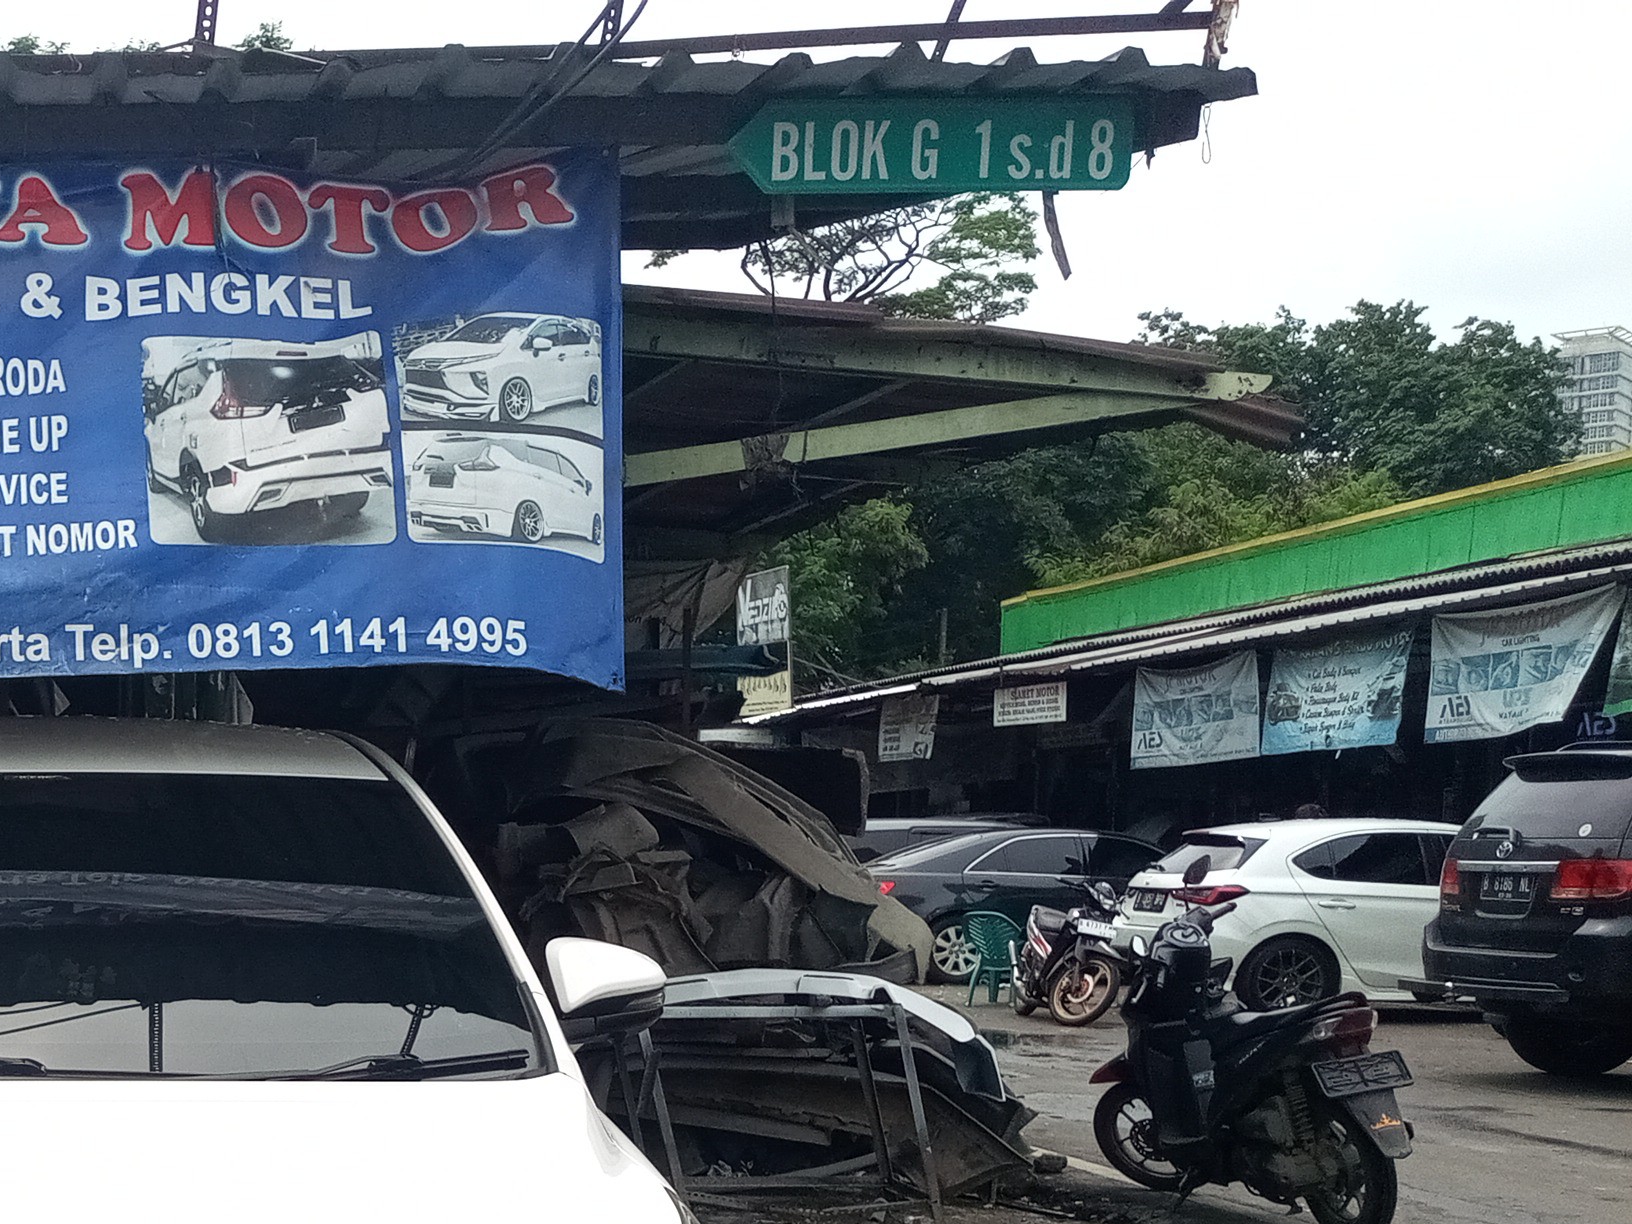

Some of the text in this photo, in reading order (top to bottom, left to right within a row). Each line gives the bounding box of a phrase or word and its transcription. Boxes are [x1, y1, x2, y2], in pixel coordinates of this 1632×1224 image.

[771, 119, 892, 181] BLOK
[911, 118, 940, 180] G
[974, 118, 993, 179] 1
[1087, 118, 1115, 180] 8
[119, 164, 575, 254] MOTOR
[19, 271, 63, 321] &
[84, 271, 374, 322] BENGKEL
[28, 414, 69, 453] UP
[25, 518, 139, 556] NOMOR
[65, 623, 173, 669] Telp.
[187, 620, 294, 660] 0813
[309, 615, 409, 656] 1141
[426, 616, 529, 658] 4995
